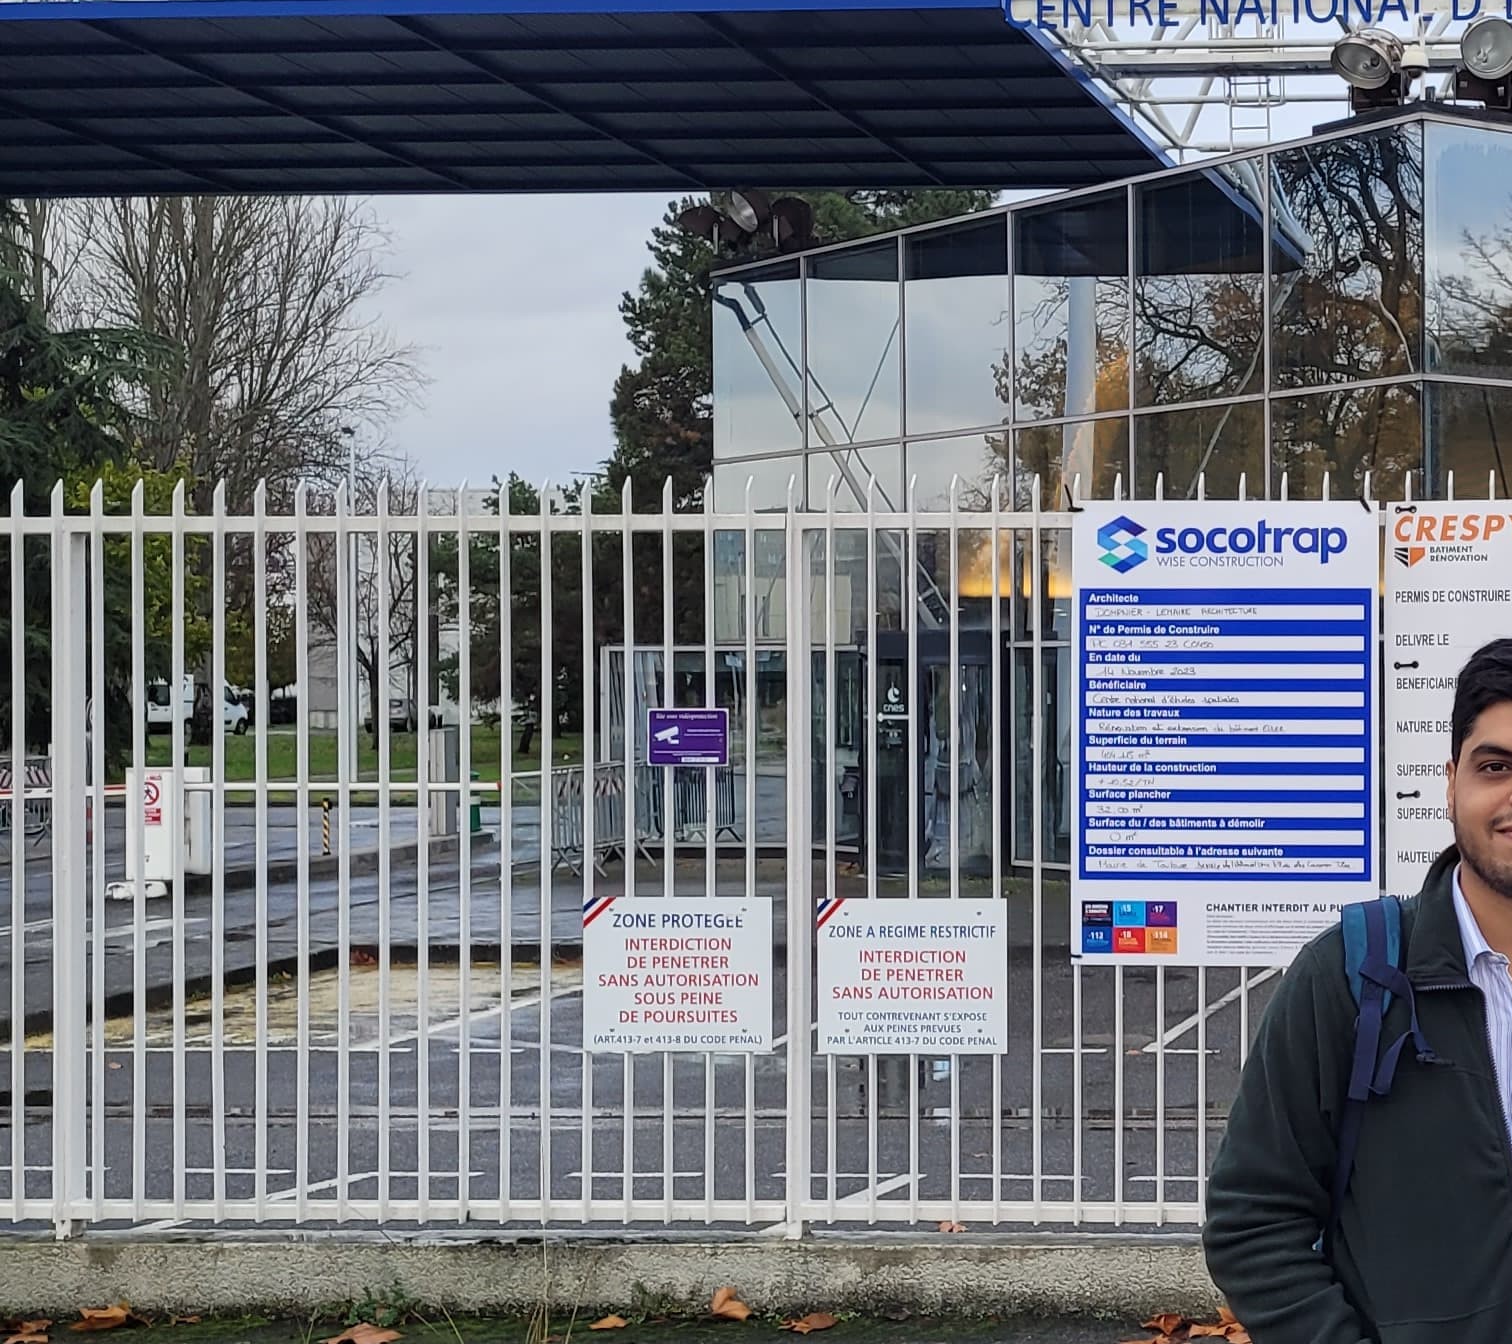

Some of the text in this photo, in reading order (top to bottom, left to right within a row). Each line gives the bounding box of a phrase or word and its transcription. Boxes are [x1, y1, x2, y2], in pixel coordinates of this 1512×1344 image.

[1155, 520, 1347, 564] socotrap
[1156, 556, 1283, 567] WISE CONSTRUCTION
[1089, 593, 1138, 603] Architecte
[1395, 590, 1430, 603] PERMIS
[1432, 590, 1445, 602] DE
[1448, 590, 1510, 602] CONSTRUIRE
[1103, 625, 1115, 634] de
[1117, 625, 1151, 634] Permis
[1153, 625, 1167, 634] de
[1168, 625, 1220, 634] Construire
[1396, 634, 1449, 646] DELIVRE LE
[1089, 653, 1141, 662] En date du
[1089, 680, 1146, 690] Bénéficiaire
[1089, 708, 1180, 717] Nature des travaux
[1397, 721, 1433, 733] NATURE
[1089, 735, 1187, 746] Superficie du terrain
[1089, 763, 1216, 772] Hauteur de la construction
[1089, 790, 1171, 802] Surface plancher
[1089, 818, 1126, 828] Surface
[1128, 818, 1141, 828] du
[1149, 818, 1167, 828] des
[1170, 818, 1217, 828] bâtiments
[1219, 818, 1226, 828] à
[1228, 818, 1265, 828] démolir
[1089, 846, 1283, 856] Dossier consultable à l'adresse suivante
[1206, 904, 1343, 912] CHANTIER INTERDIT AU PU
[613, 913, 743, 928] ZONE PROTEGEE
[829, 925, 996, 938] ZONE A REGIME RESTRICTIF
[625, 938, 731, 951] INTERDICTION
[859, 950, 966, 963] INTERDICTION
[627, 956, 729, 969] DE PENETRER
[861, 968, 964, 981] DE PENETRER
[598, 974, 759, 987] SANS AUTORISATION
[634, 992, 722, 1005] SOUS PEINE
[832, 986, 993, 1000] SANS AUTORISATION
[619, 1010, 738, 1023] DE POURSUITES
[838, 1012, 987, 1021] TOUT CONTREVENANT S'EXPOSE
[864, 1024, 962, 1033] AUX PEINES PREVUES
[644, 1035, 653, 1044] et
[656, 1035, 681, 1044] 413-8
[684, 1035, 697, 1044] DU
[700, 1035, 726, 1044] CODE
[729, 1035, 763, 1044] PENAL)
[827, 1036, 997, 1045] PAR L'ARTICLE 413-7 DU CODE PENAL
